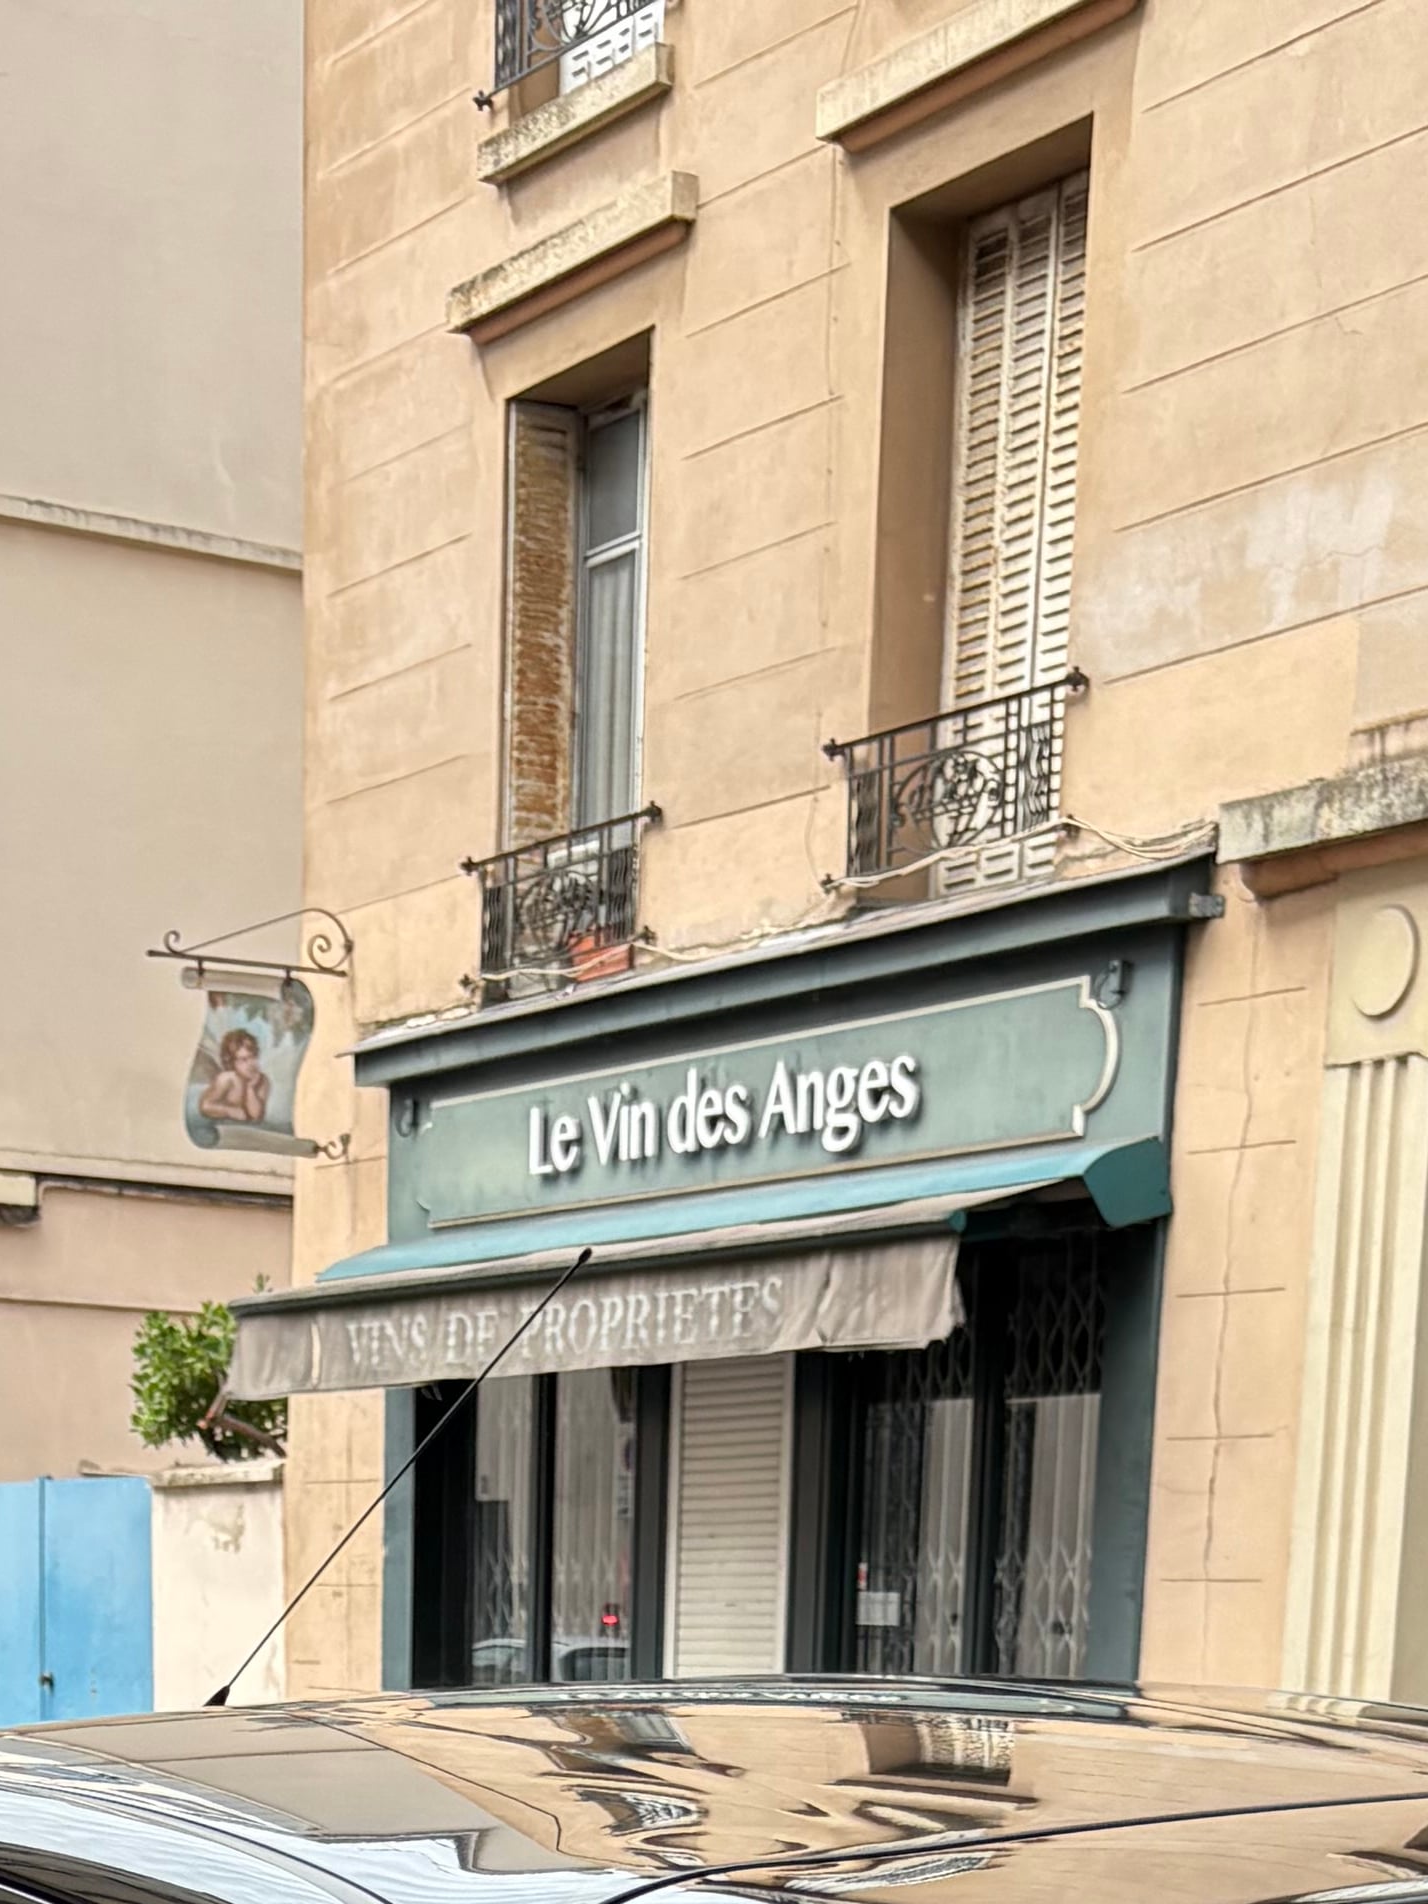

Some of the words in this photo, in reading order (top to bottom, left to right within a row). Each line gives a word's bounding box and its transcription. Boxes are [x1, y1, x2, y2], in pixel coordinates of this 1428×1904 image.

[528, 1106, 580, 1176] Le
[587, 1080, 655, 1166] Vin
[667, 1066, 751, 1154] des
[758, 1054, 920, 1153] Anges
[345, 1314, 428, 1369] VINS
[520, 1277, 784, 1360] PROPRIETES
